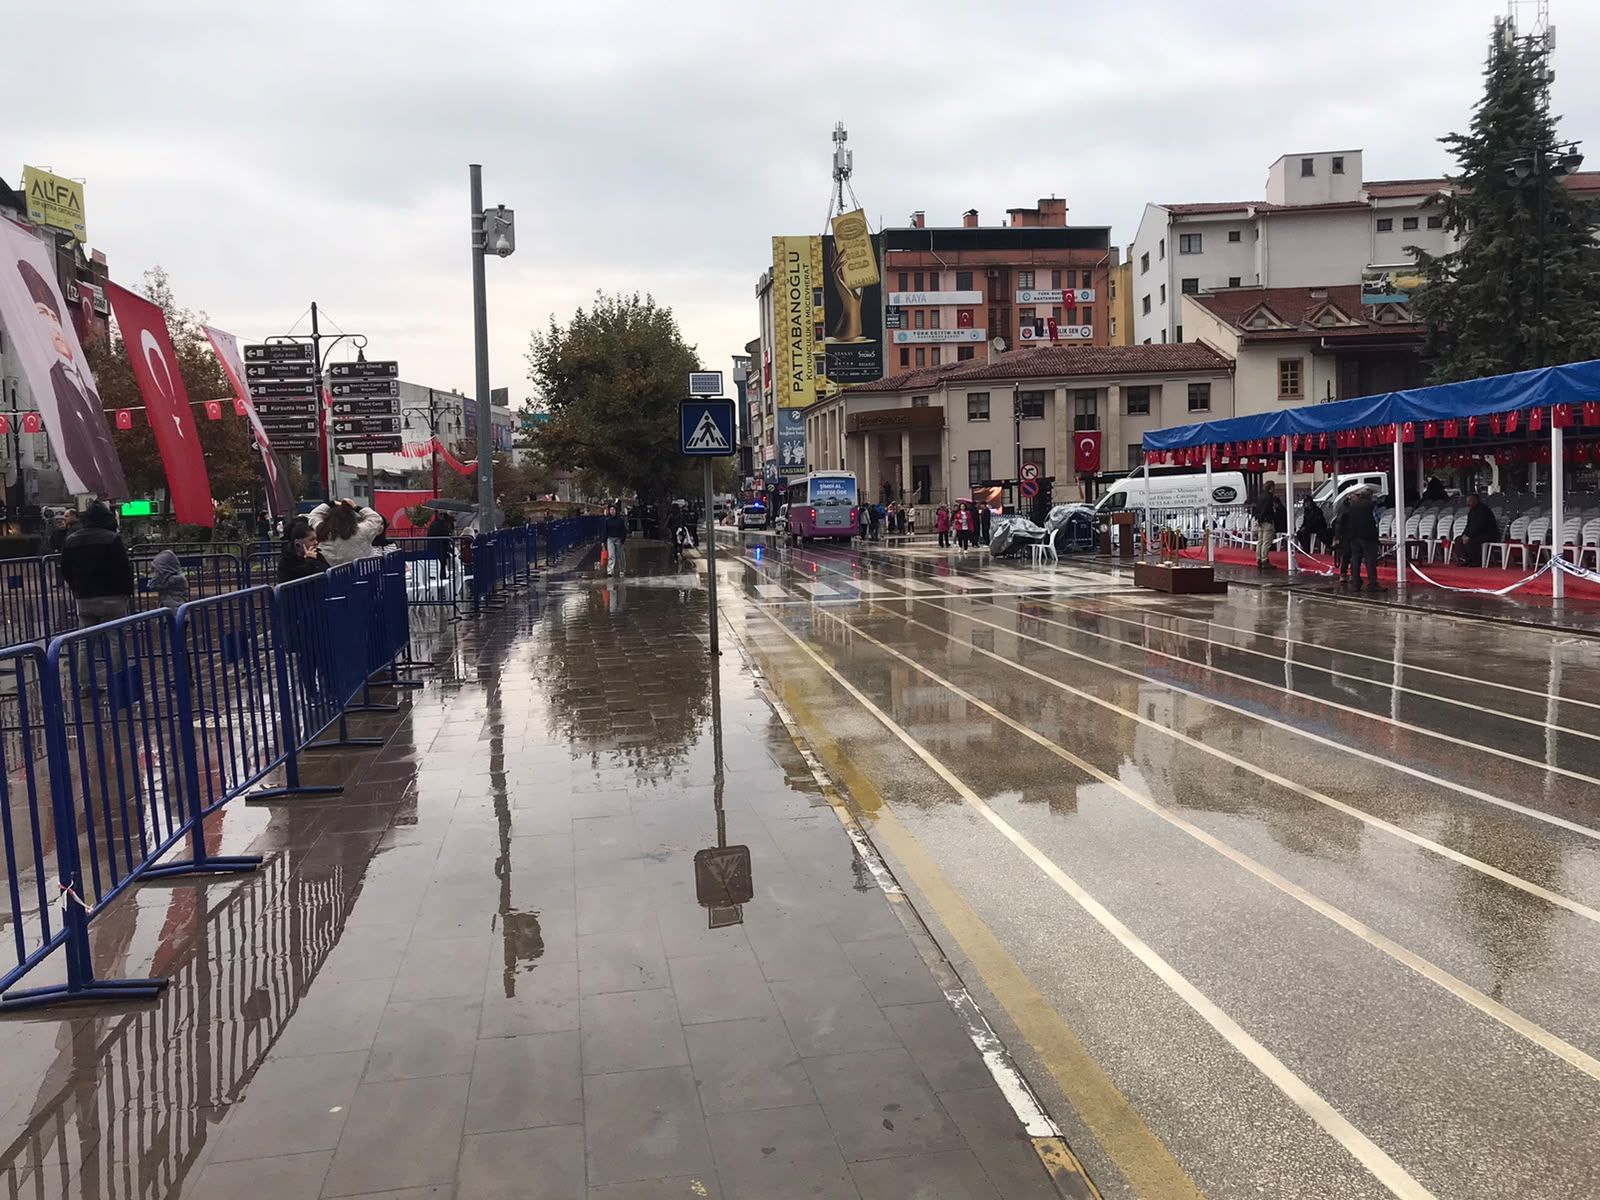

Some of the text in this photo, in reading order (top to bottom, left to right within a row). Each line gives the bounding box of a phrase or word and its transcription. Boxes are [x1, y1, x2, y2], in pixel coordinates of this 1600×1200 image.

[787, 251, 804, 392] PATTABANOĞLU
[905, 293, 927, 304] KAYA
[804, 332, 813, 380] KUYUMCULUK
